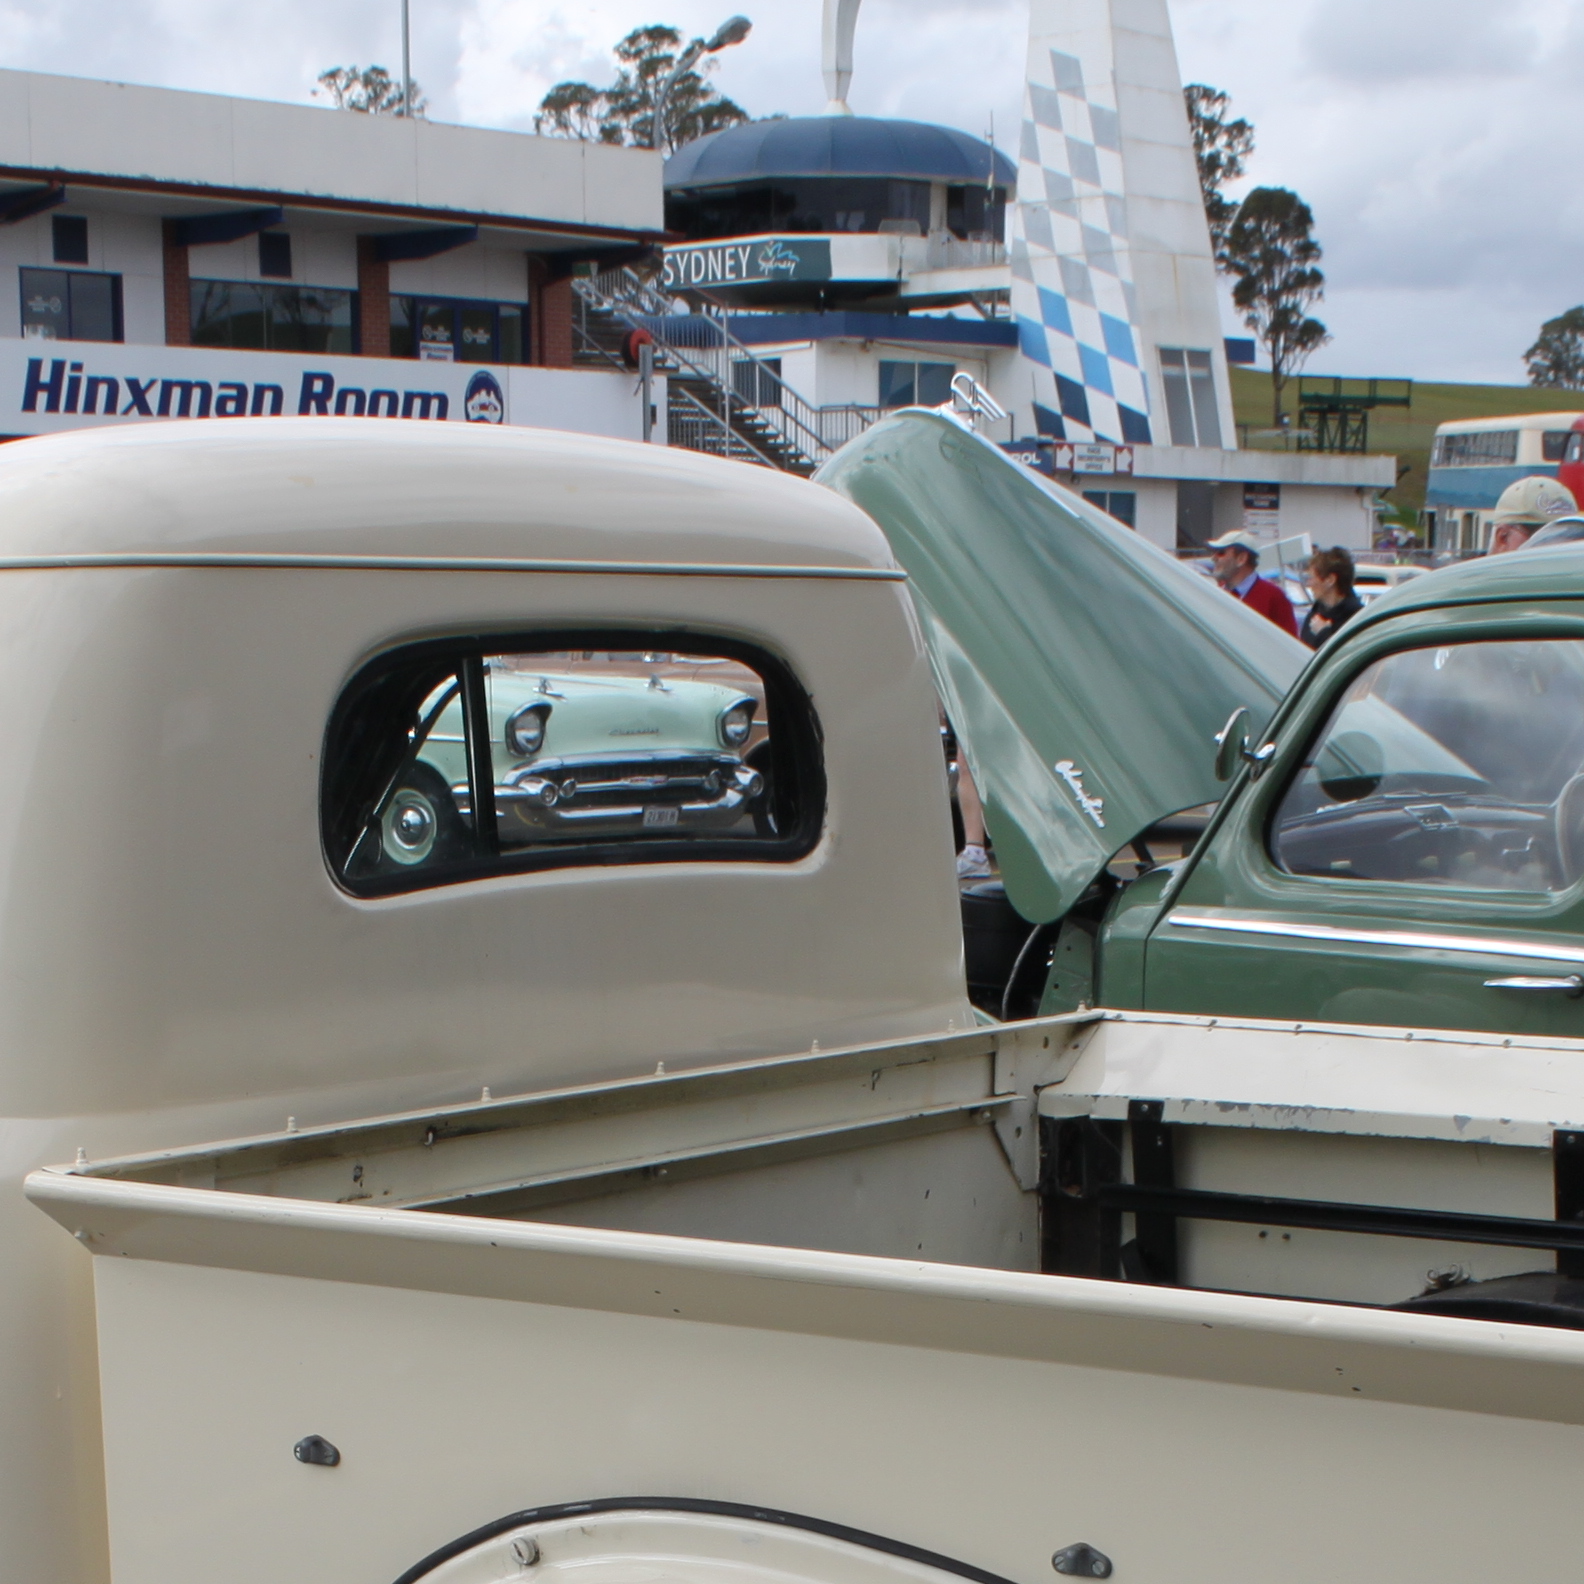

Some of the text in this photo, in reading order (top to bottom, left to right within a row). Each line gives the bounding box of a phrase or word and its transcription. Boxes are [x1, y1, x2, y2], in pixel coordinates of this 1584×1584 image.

[663, 246, 751, 286] SYDNEY
[21, 356, 284, 417] Hinxman
[298, 370, 449, 420] Room
